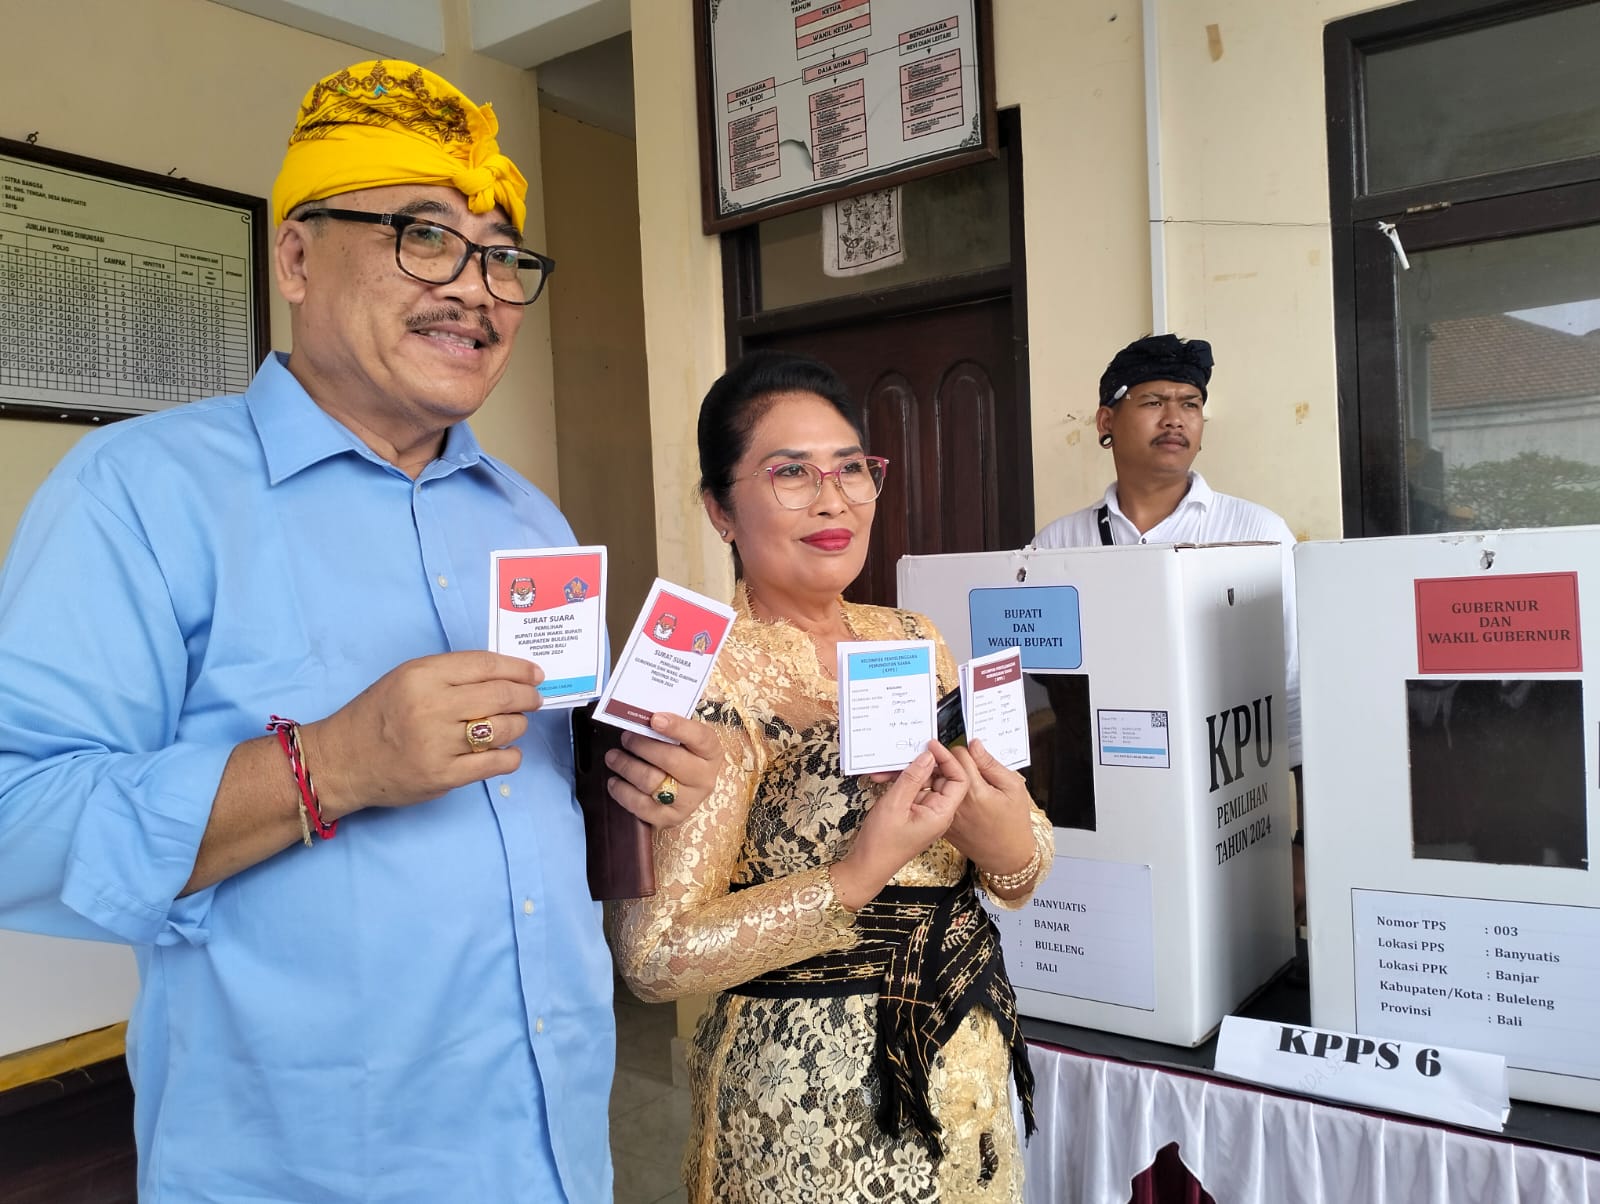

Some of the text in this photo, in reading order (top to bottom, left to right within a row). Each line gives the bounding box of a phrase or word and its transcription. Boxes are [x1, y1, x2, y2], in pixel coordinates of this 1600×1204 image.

[822, 4, 842, 15] KETUA
[812, 22, 853, 42] WAKIL KETUA
[909, 22, 948, 40] BENDAHARA
[735, 82, 766, 98] BENDAHARA
[104, 256, 126, 266] CAMPAK
[1004, 608, 1042, 619] BUPATI
[1452, 600, 1539, 614] GUBERNUR
[523, 614, 575, 625] SURAT SUARA
[1480, 616, 1512, 628] DAN
[1013, 623, 1035, 633] DAN
[988, 637, 1063, 647] WAKIL BUPATI
[1428, 629, 1572, 644] WAKIL GUBERNUR
[654, 650, 692, 667] SURAT SUARA
[1206, 694, 1272, 793] KPU
[1217, 782, 1268, 829] PEMILIHAN
[1216, 813, 1272, 866] TAHUN 2024
[1033, 898, 1087, 912] BANYUATIS
[1034, 919, 1070, 932] BANJAR
[1377, 916, 1419, 928] Nomor
[1422, 920, 1446, 931] TPS
[1494, 926, 1518, 937] 003
[1035, 940, 1085, 956] BULELENG
[1378, 937, 1418, 950] Lokasi
[1421, 941, 1445, 952] PPS
[1495, 948, 1560, 963] Banyuatis
[1036, 962, 1058, 973] BALI
[1379, 959, 1418, 972] Lokasi
[1422, 963, 1448, 975] PPK
[1496, 970, 1540, 984] Banjar
[1380, 980, 1483, 1001] Kabupaten/Kota
[1496, 992, 1555, 1010] Buleleng
[1381, 1002, 1432, 1016] Provinsi
[1497, 1014, 1522, 1026] Bali
[1276, 1026, 1442, 1077] KPPS 6
